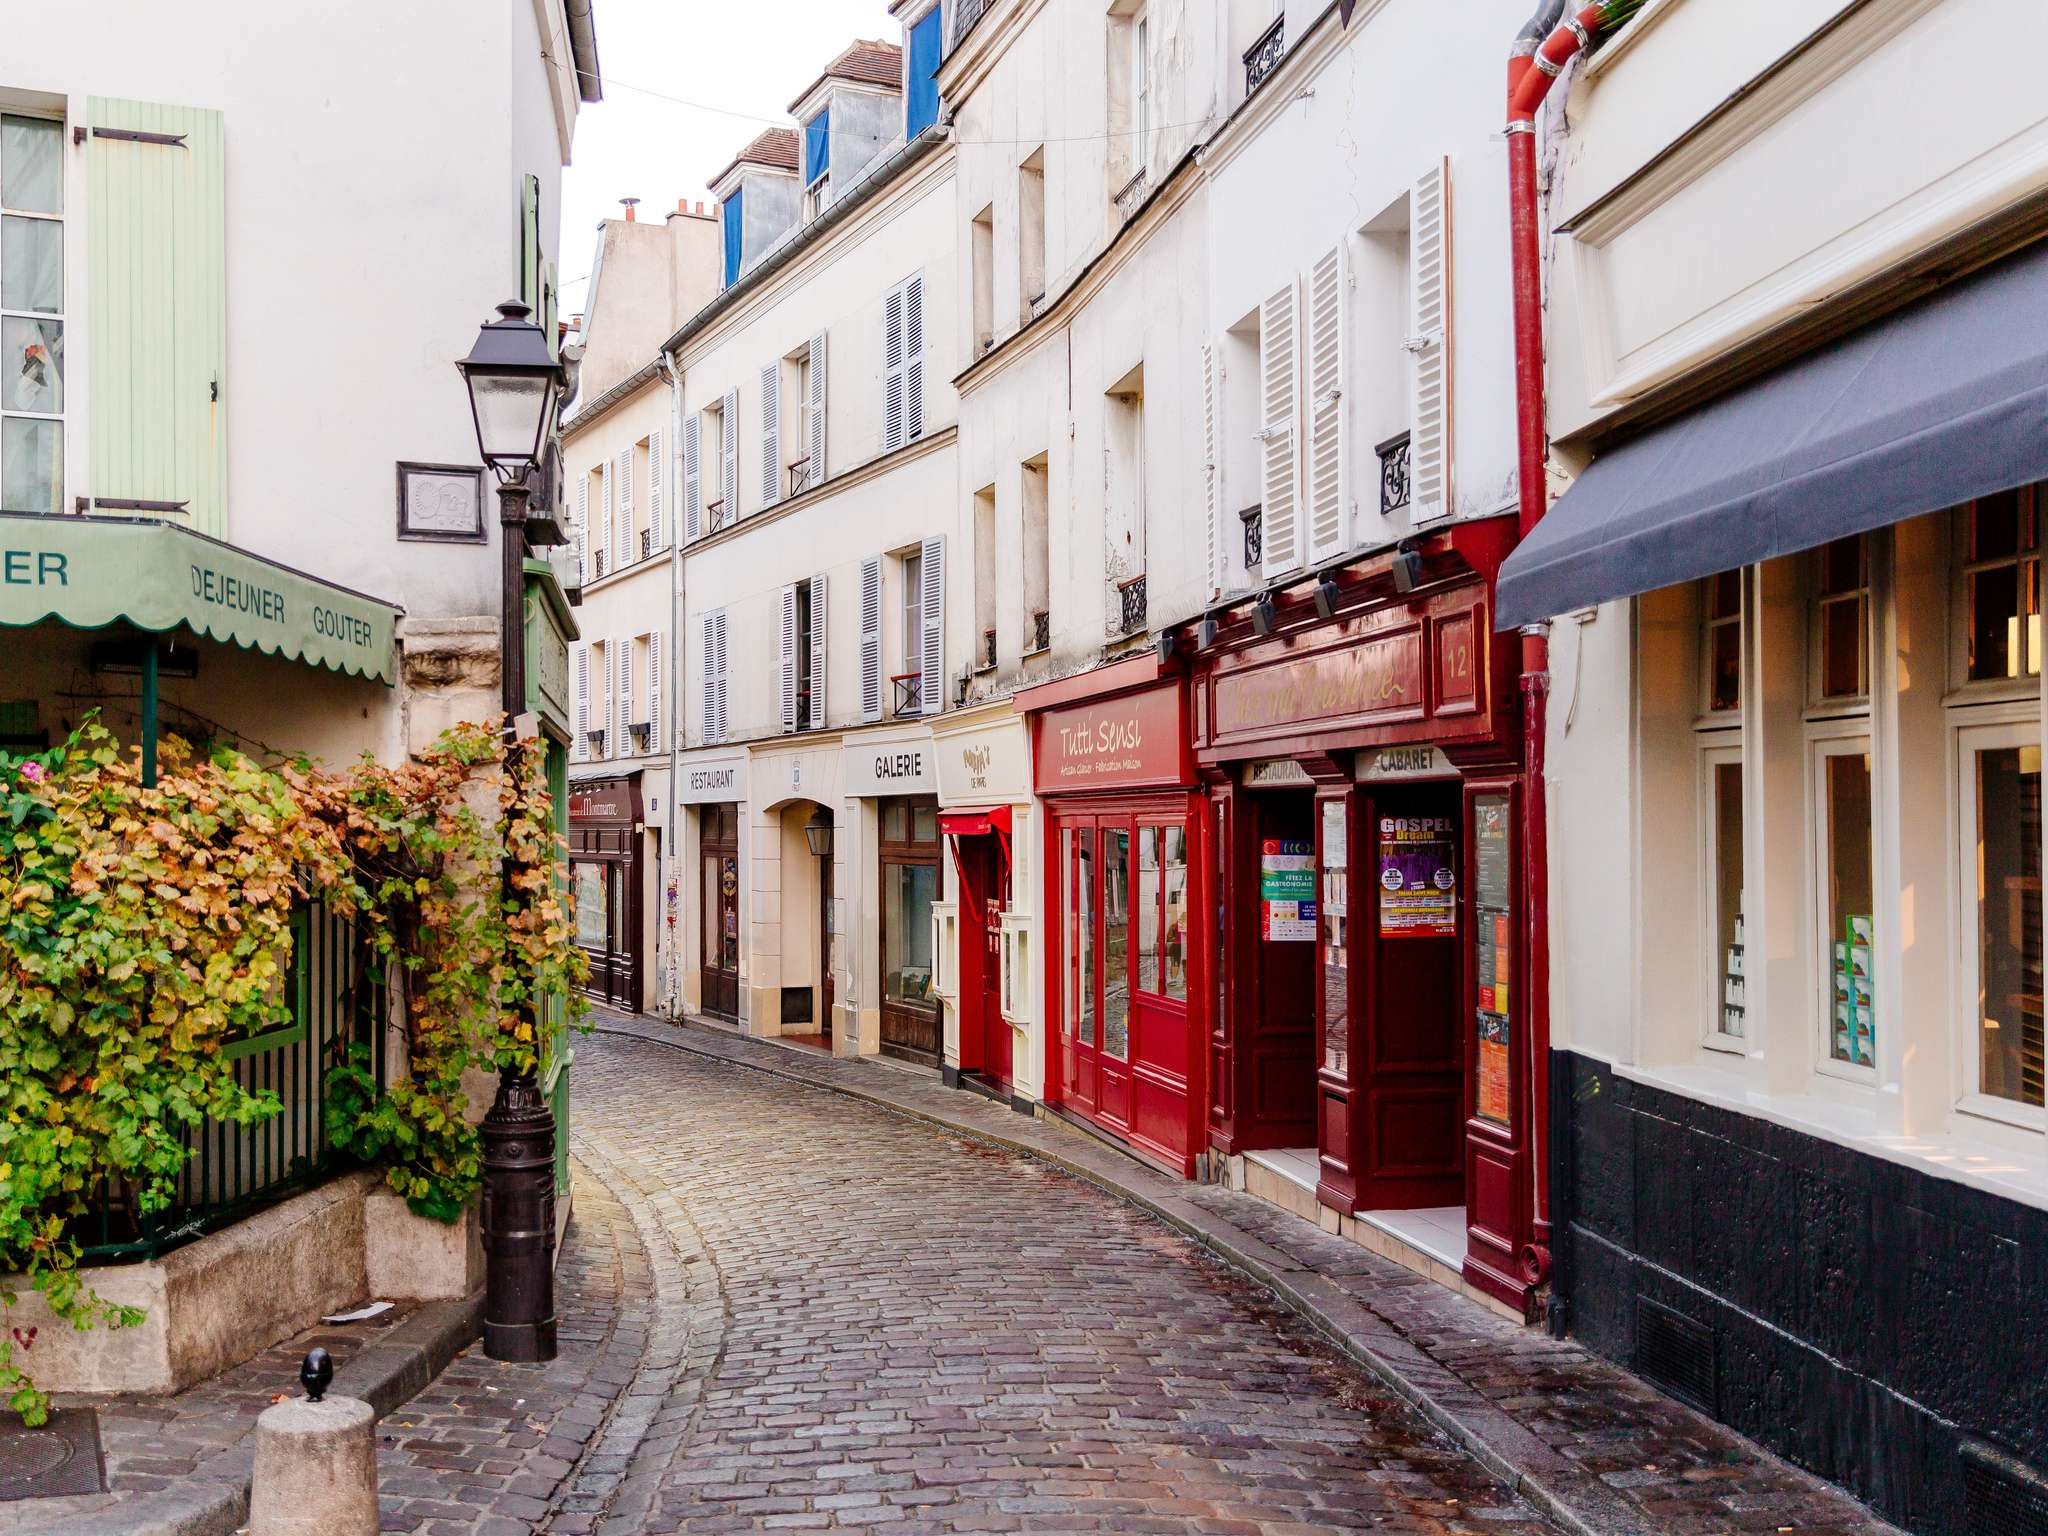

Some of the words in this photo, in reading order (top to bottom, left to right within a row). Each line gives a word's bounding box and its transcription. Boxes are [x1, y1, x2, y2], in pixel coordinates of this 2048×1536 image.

[4, 550, 68, 586] ER
[190, 564, 285, 624] DEJEUNER
[313, 606, 372, 648] GOUTER
[1447, 645, 1466, 680] 12
[1060, 711, 1094, 758] Tutti
[1096, 702, 1142, 753] Sensi
[875, 753, 922, 779] GALERIE
[1380, 750, 1435, 773] CABARET
[690, 769, 735, 790] RESTAURANT
[1380, 818, 1453, 833] GOSPEL
